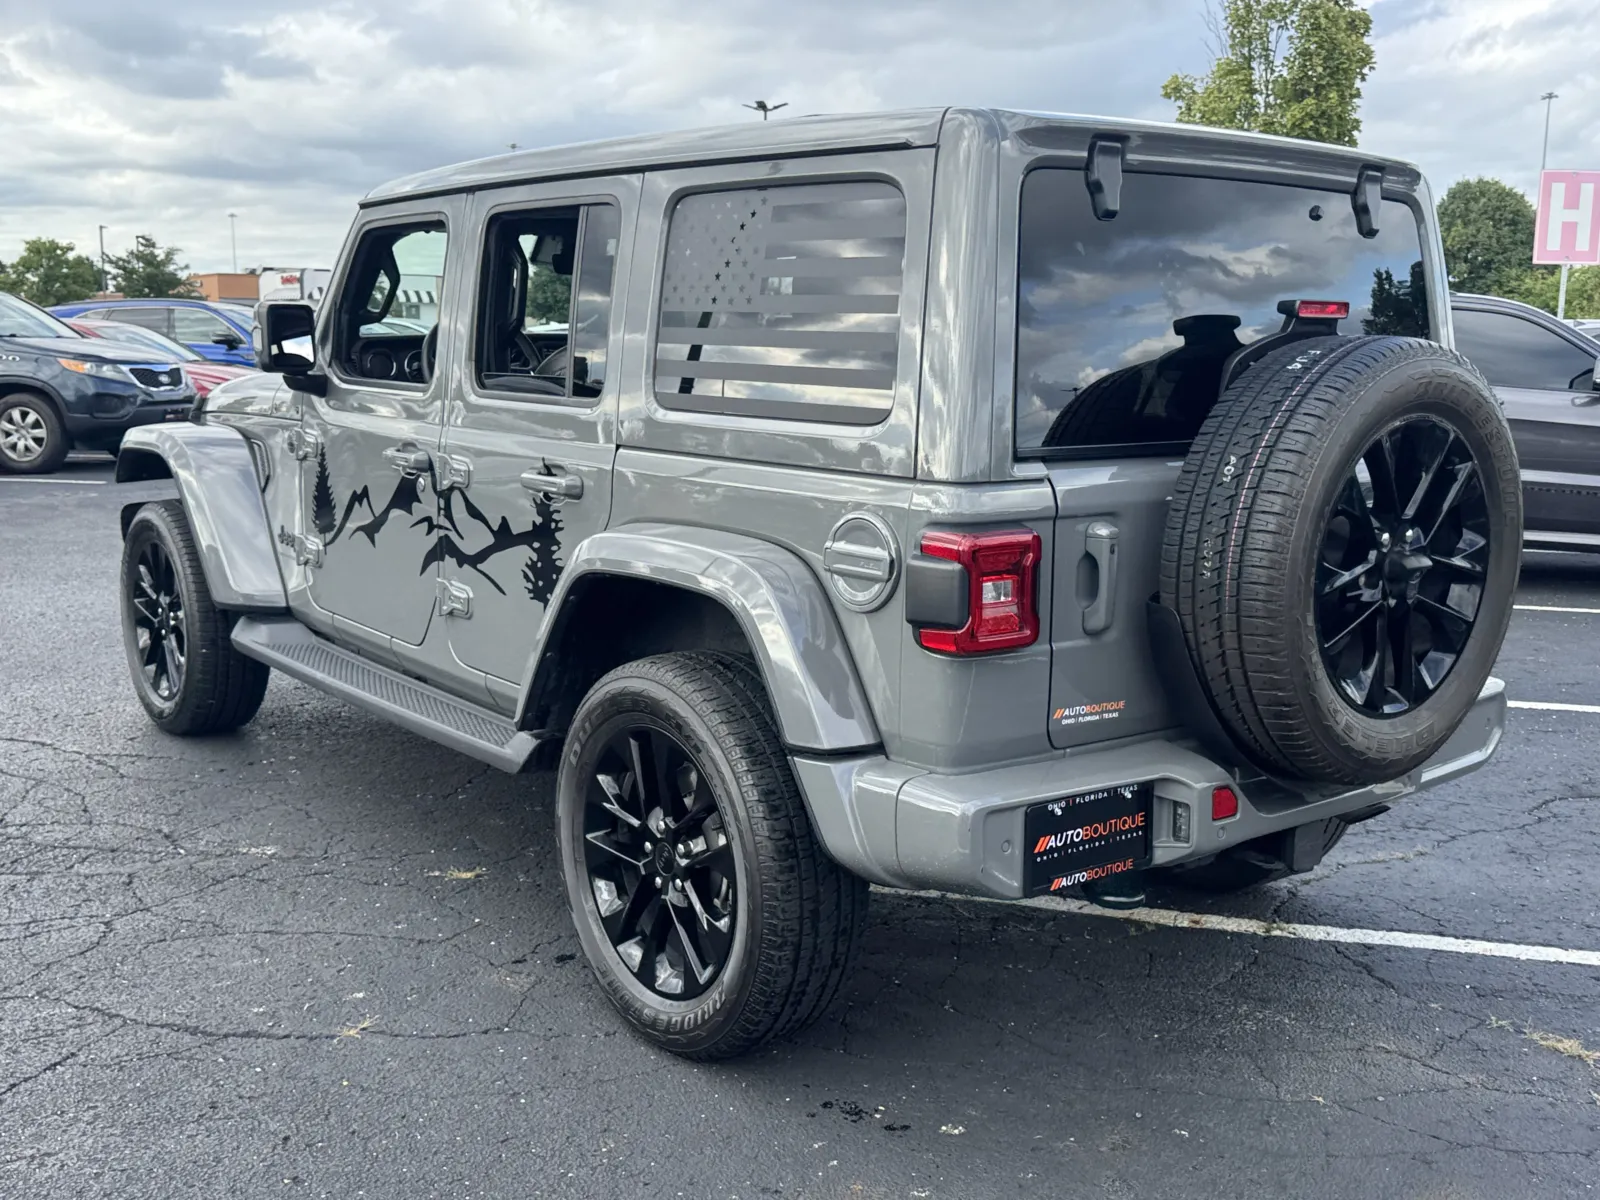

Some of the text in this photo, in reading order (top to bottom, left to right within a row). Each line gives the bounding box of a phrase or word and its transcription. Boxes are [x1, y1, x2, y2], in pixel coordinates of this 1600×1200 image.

[1546, 182, 1594, 251] H
[1062, 700, 1126, 717] AUTOBOUTIQUE
[1078, 714, 1100, 723] FLORIDA
[1047, 784, 1138, 811] OHIO FLORIDA TEXAS
[1036, 830, 1143, 862] OHIO FLORIDA TEXAS
[1046, 812, 1145, 850] AUTOBOUTIQUE
[1059, 858, 1134, 888] AUTOBOUTIQUE
[597, 963, 726, 1032] BRIDGESTONE
